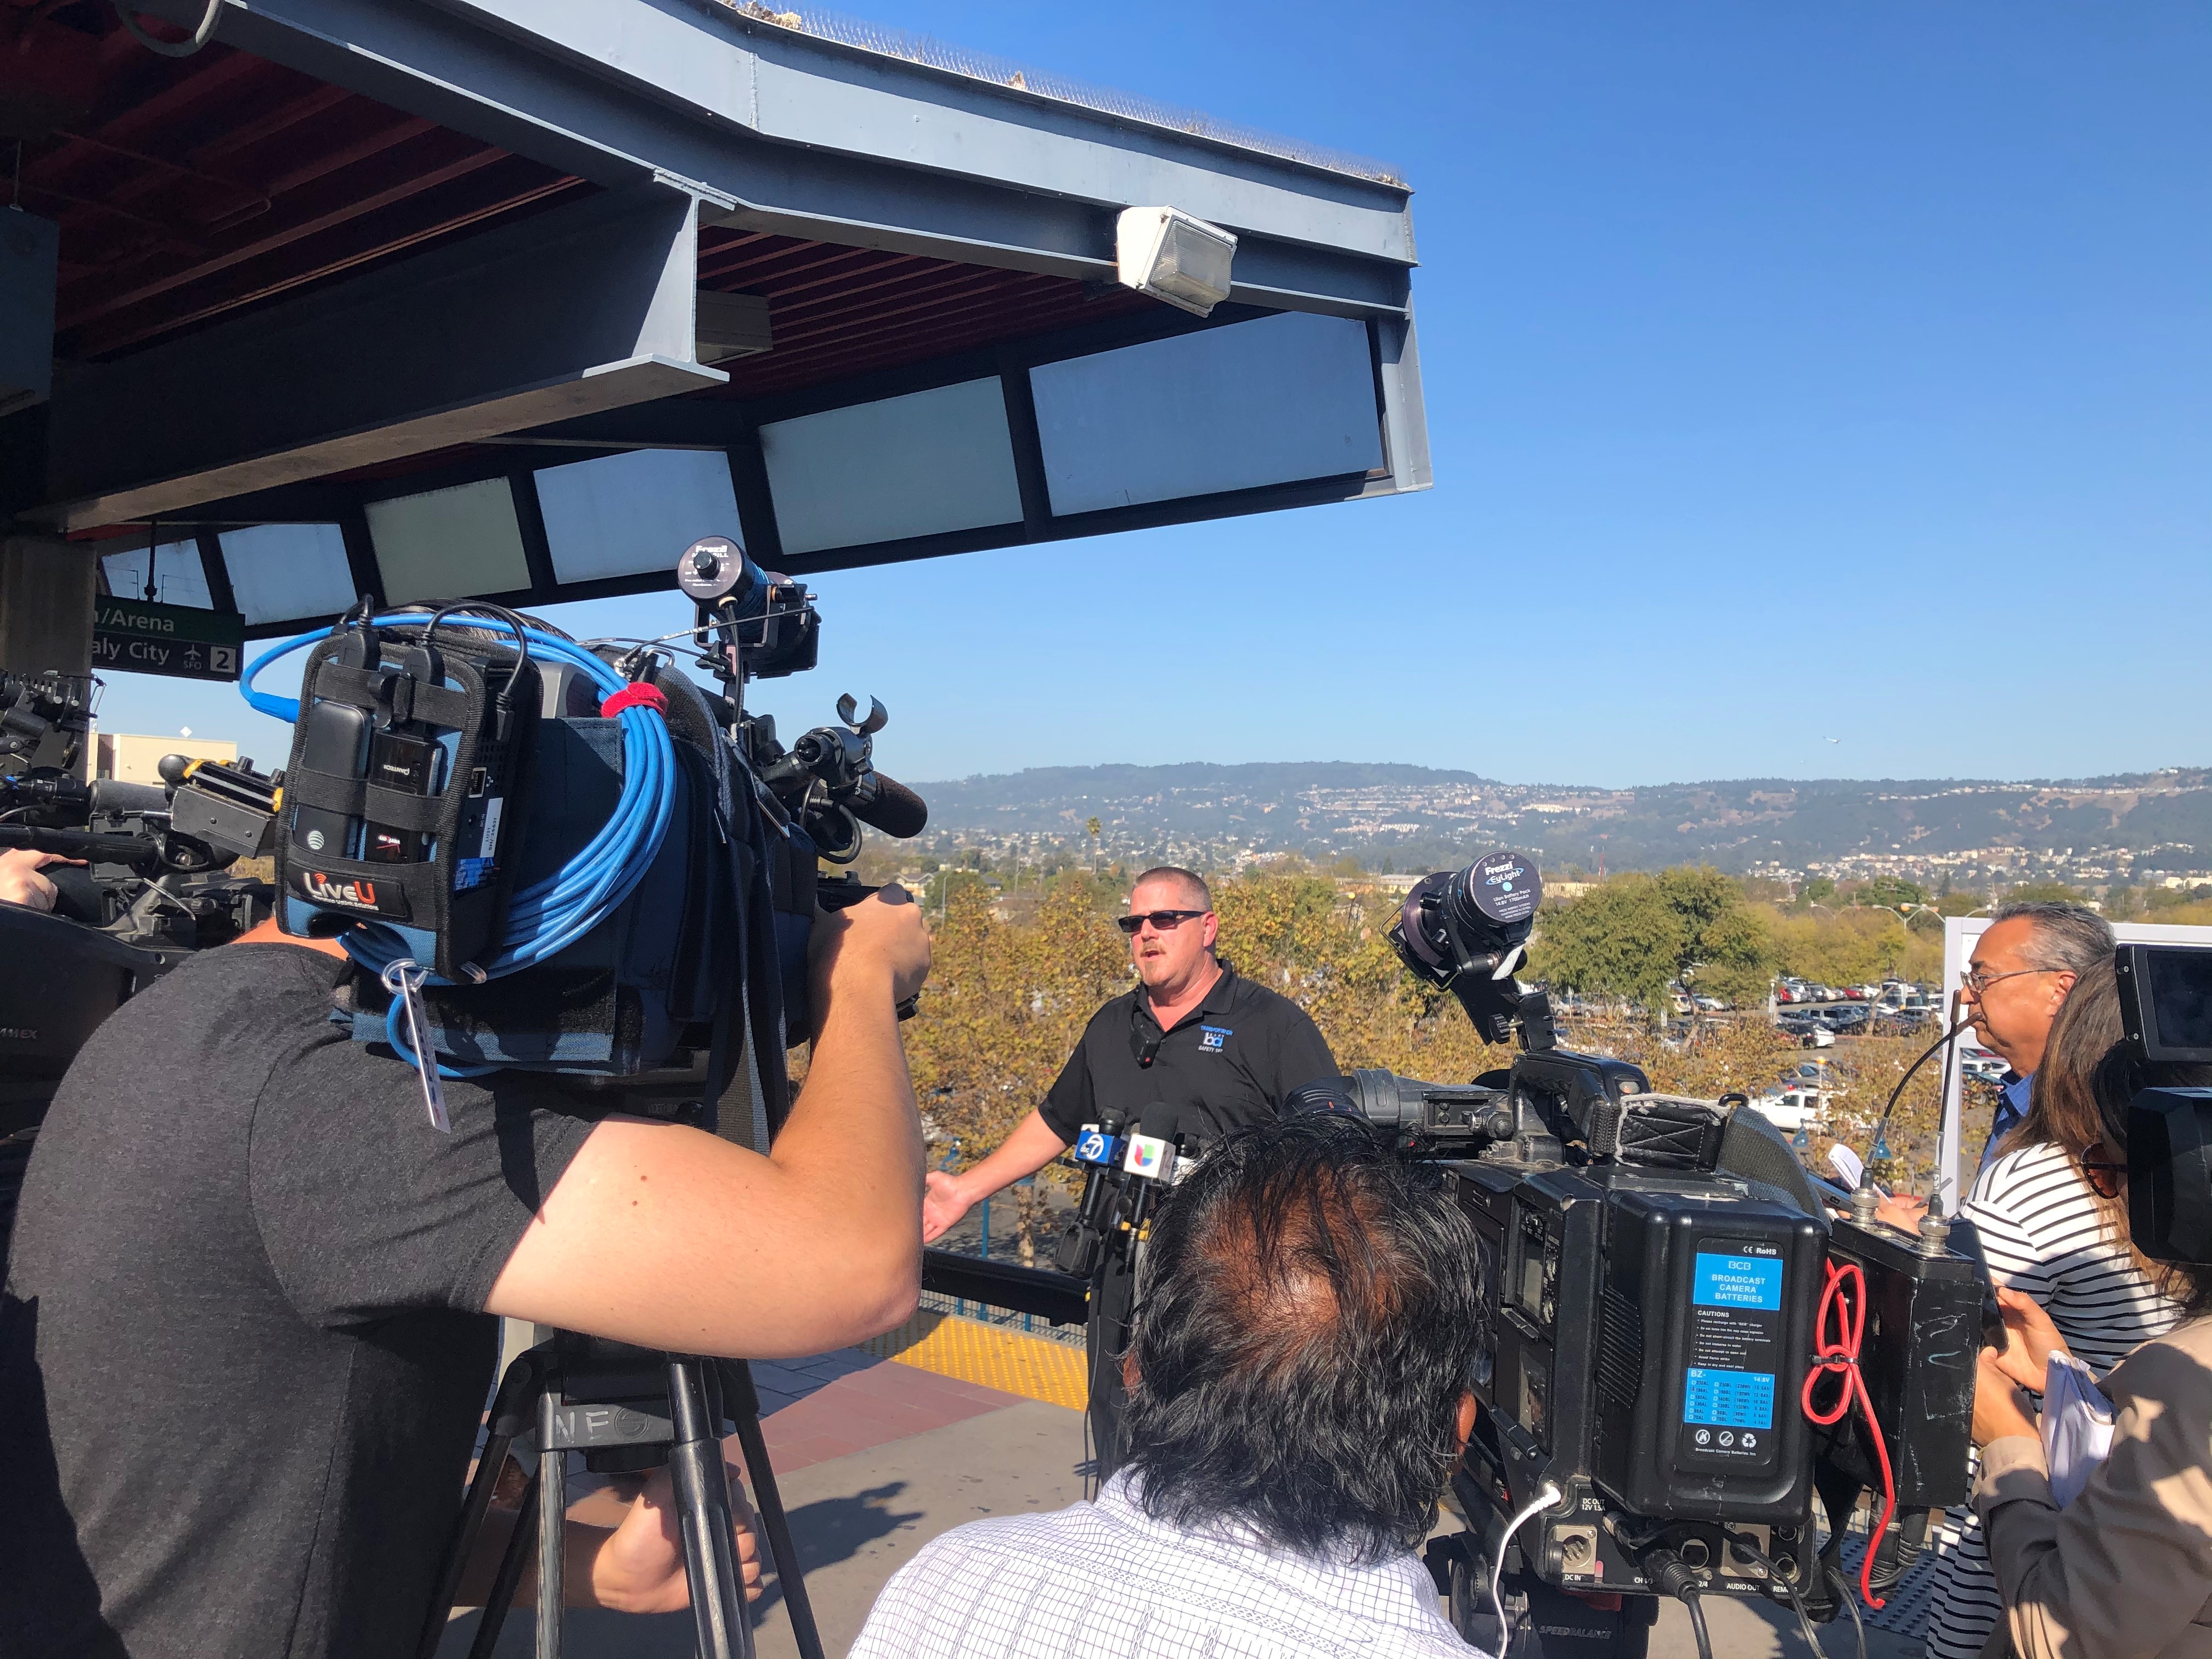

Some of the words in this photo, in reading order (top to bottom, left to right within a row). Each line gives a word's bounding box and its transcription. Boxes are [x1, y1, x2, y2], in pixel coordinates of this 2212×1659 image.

[129, 641, 170, 665] City
[216, 651, 229, 669] 2
[183, 660, 202, 670] SFO
[1485, 861, 1513, 876] Frezzi
[1491, 870, 1520, 883] EyLight
[1728, 1261, 1751, 1271] BCB
[1712, 1274, 1766, 1285] BROADCAST
[1720, 1284, 1757, 1294] CAMERA
[1715, 1293, 1763, 1303] BATTERIES
